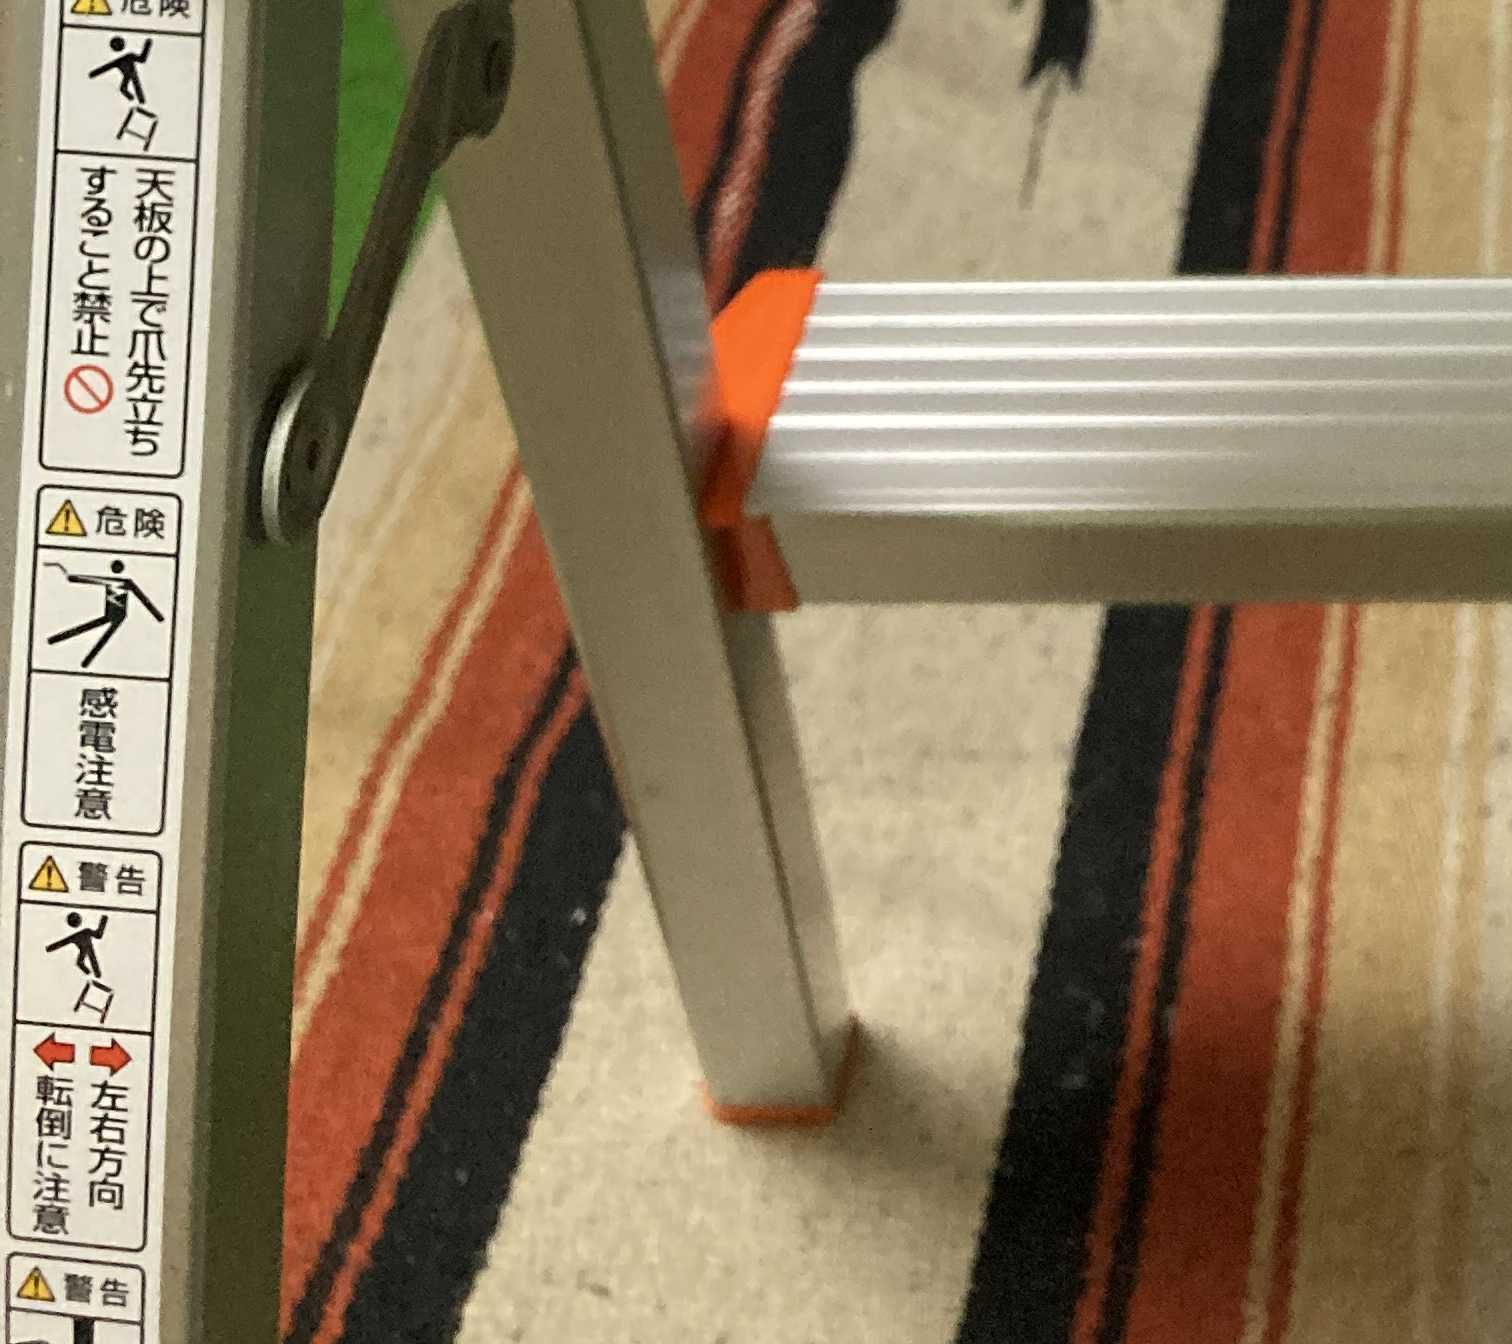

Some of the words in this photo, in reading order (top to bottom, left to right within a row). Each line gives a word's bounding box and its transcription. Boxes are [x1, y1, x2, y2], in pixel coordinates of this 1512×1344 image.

[72, 166, 117, 358] すること禁止
[125, 167, 176, 457] 天板の上で爪先立ち
[95, 505, 165, 540] 危険
[75, 687, 120, 821] 感電注意
[78, 860, 147, 897] 警告
[32, 1075, 75, 1236] 転倒に注意
[89, 1080, 130, 1211] 左右方向
[64, 1272, 130, 1307] 警告
